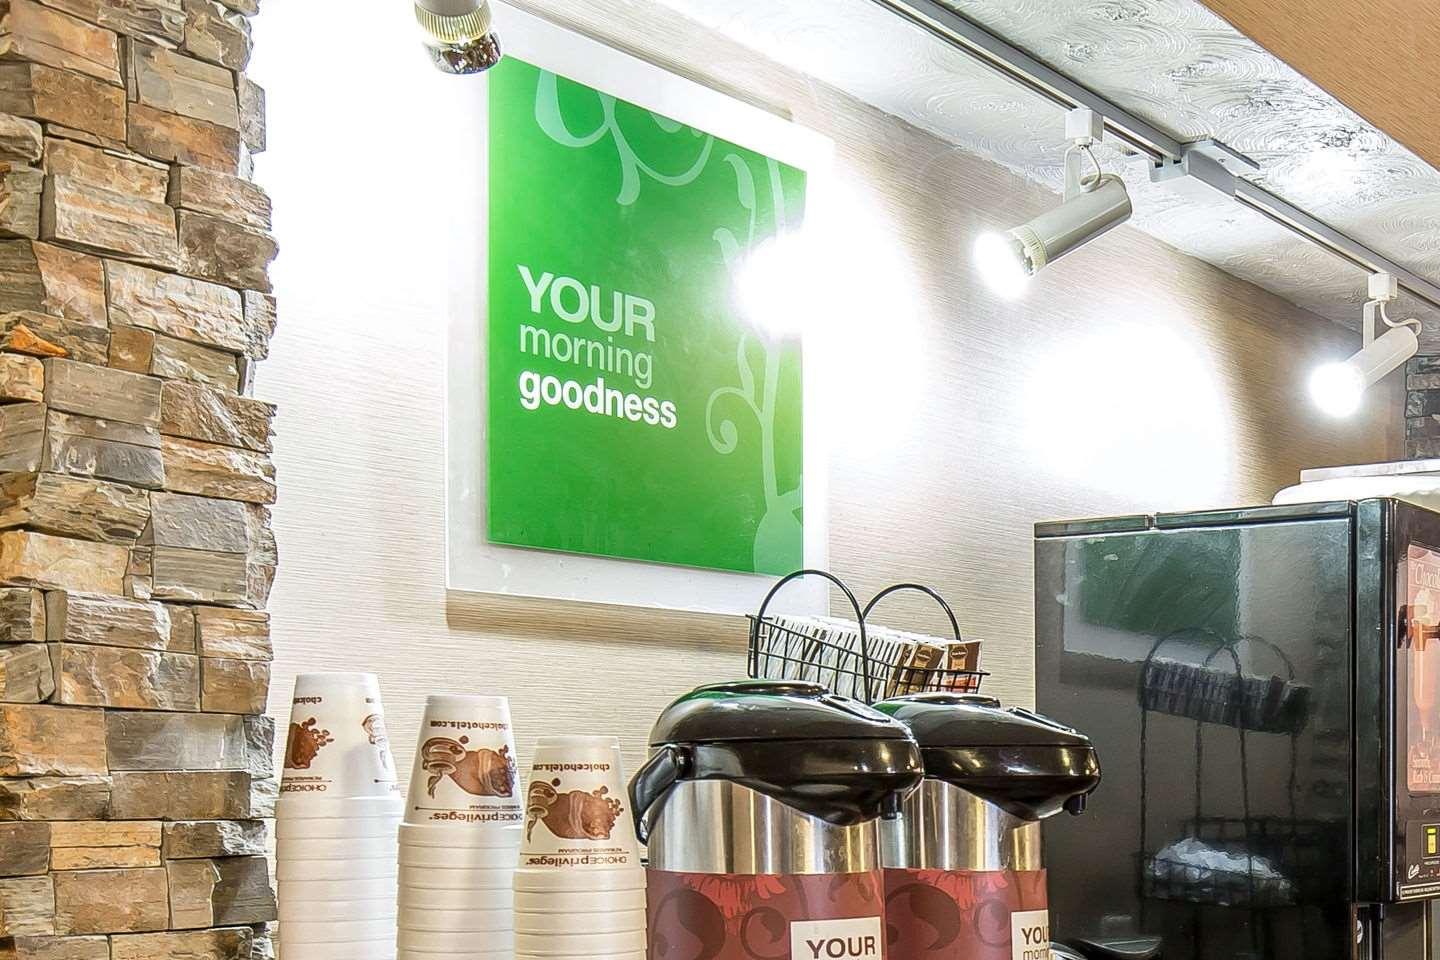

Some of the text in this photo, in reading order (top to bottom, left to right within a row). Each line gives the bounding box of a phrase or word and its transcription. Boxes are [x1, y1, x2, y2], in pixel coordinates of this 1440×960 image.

[517, 264, 656, 342] YOUR
[519, 323, 653, 389] morning
[519, 369, 678, 429] goodness
[806, 936, 876, 960] YOUR
